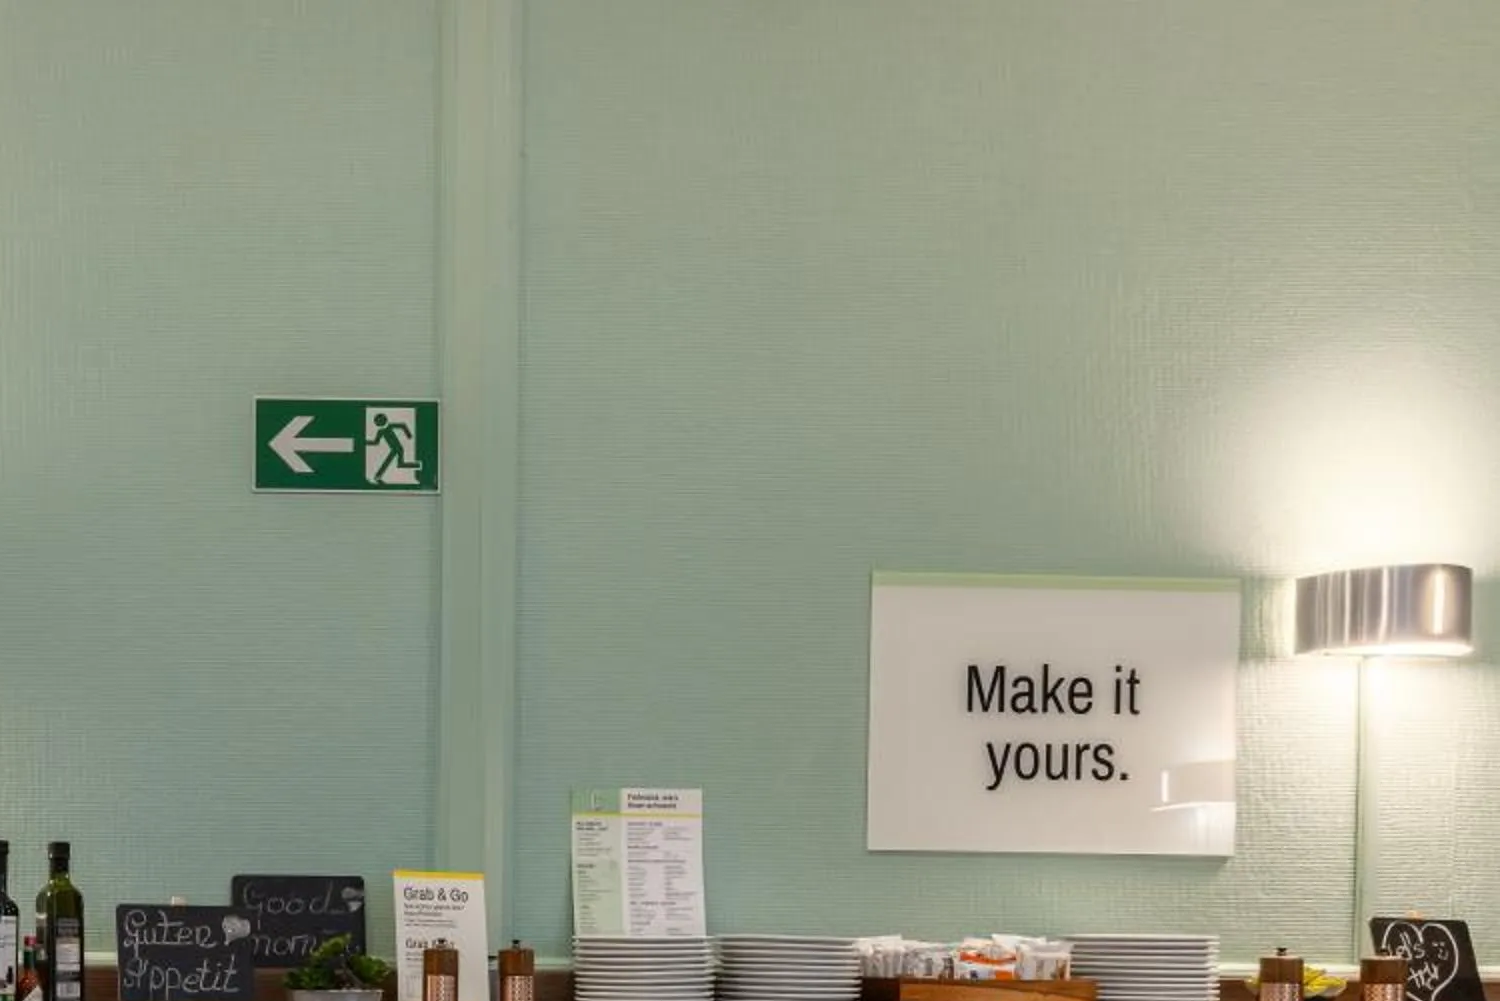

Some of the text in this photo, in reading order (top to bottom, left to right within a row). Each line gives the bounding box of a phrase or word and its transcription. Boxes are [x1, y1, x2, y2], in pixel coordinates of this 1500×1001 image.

[967, 664, 1141, 715] Make it
[986, 742, 1130, 791] yours.
[243, 879, 336, 930] Good
[403, 887, 469, 904] Grab & Go
[124, 909, 218, 959] Guten
[124, 953, 241, 1001] Appetit
